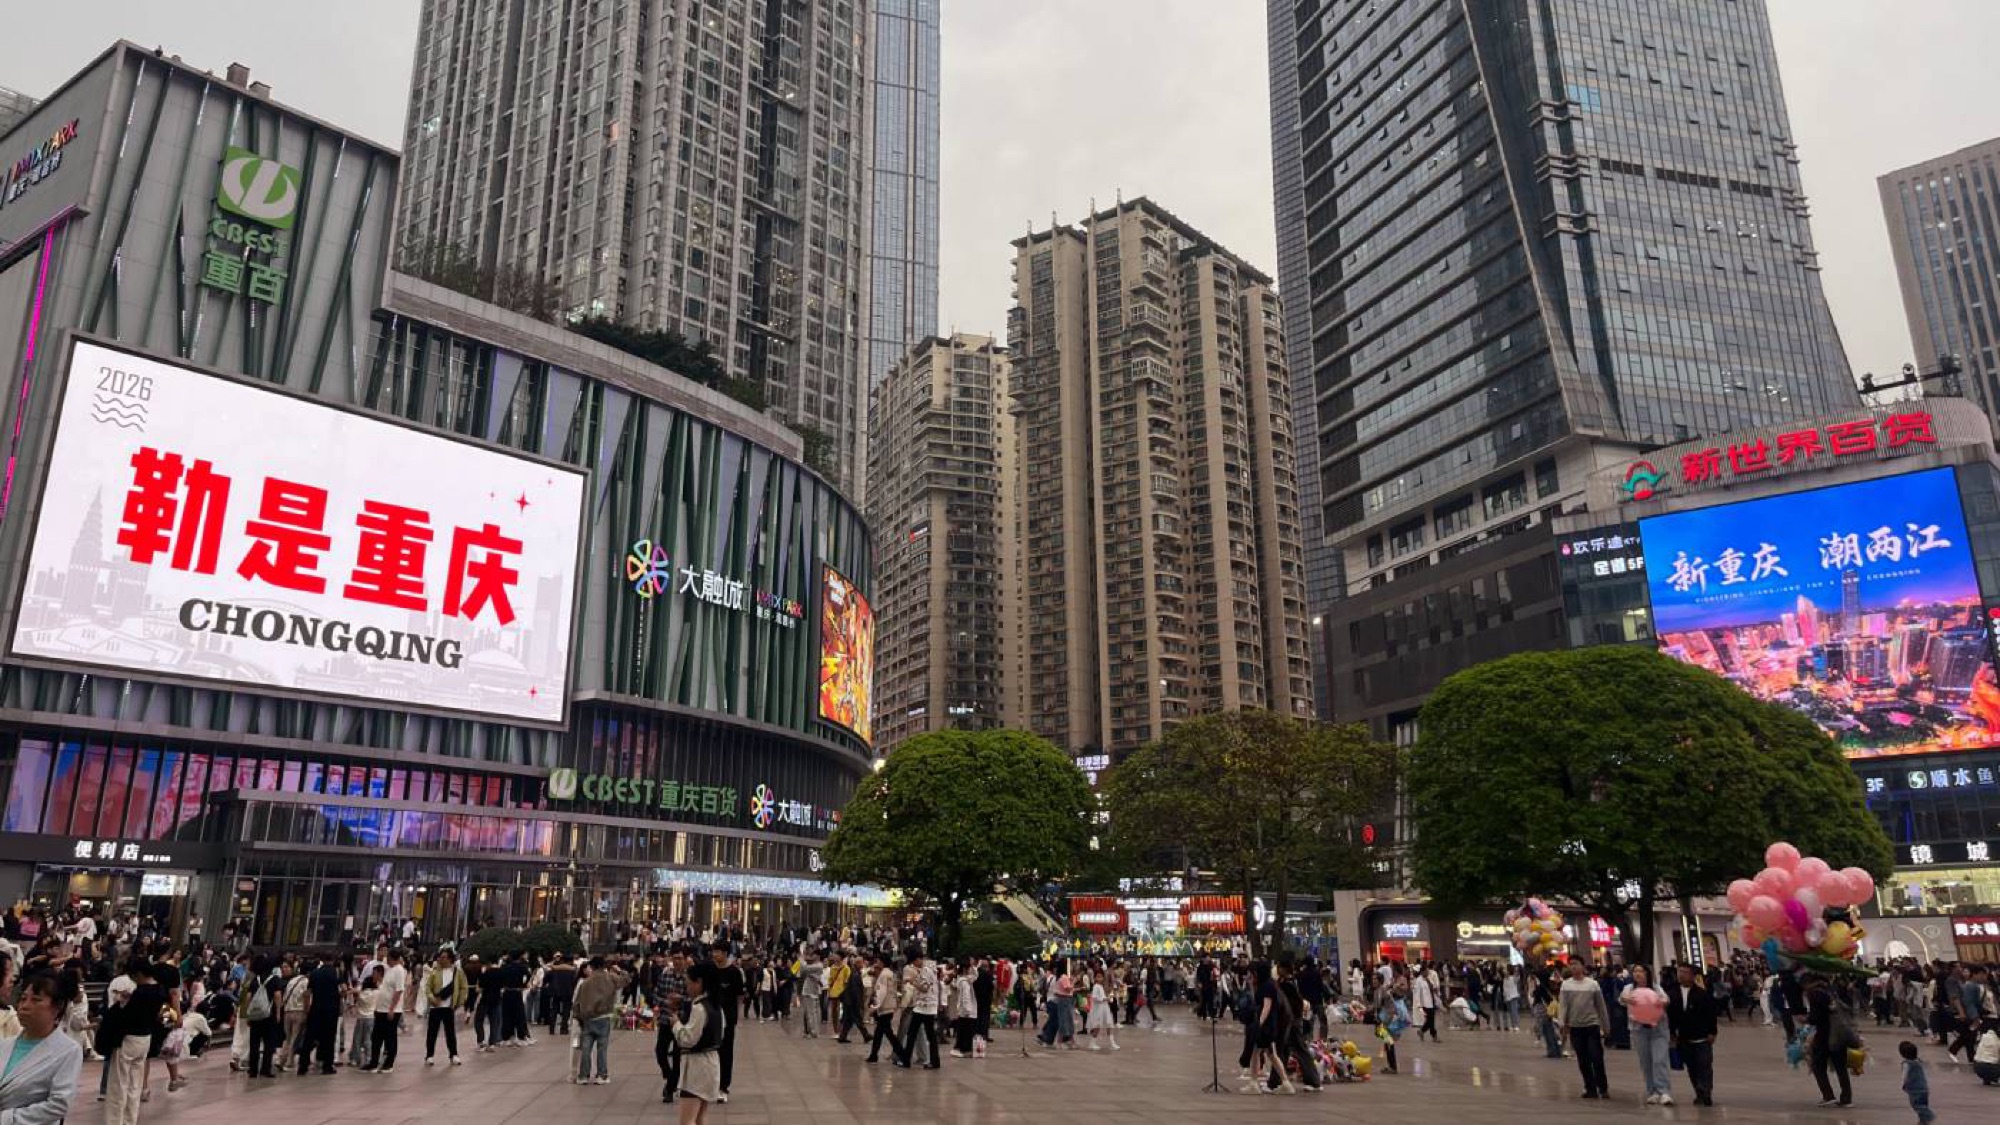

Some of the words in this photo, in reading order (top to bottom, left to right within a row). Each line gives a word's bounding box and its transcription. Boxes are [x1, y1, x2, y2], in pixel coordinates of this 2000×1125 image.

[211, 218, 287, 259] CBEST
[200, 252, 287, 306] 重百
[97, 367, 153, 402] 2026
[1681, 411, 1936, 481] 新世界百货
[117, 447, 524, 627] 勒是重庆
[1573, 535, 1623, 555] 欢乐迪
[1667, 543, 1788, 594] 新重庆
[1819, 523, 1951, 570] 潮两江
[679, 564, 743, 611] 大融城
[178, 598, 463, 668] CHONGQING
[582, 773, 655, 805] CBEST
[660, 779, 739, 817] 重庆百货
[1867, 777, 1884, 792] 3F
[1930, 765, 2000, 788] 顺水鱼
[777, 798, 812, 826] 大融城
[75, 840, 141, 861] 便利店
